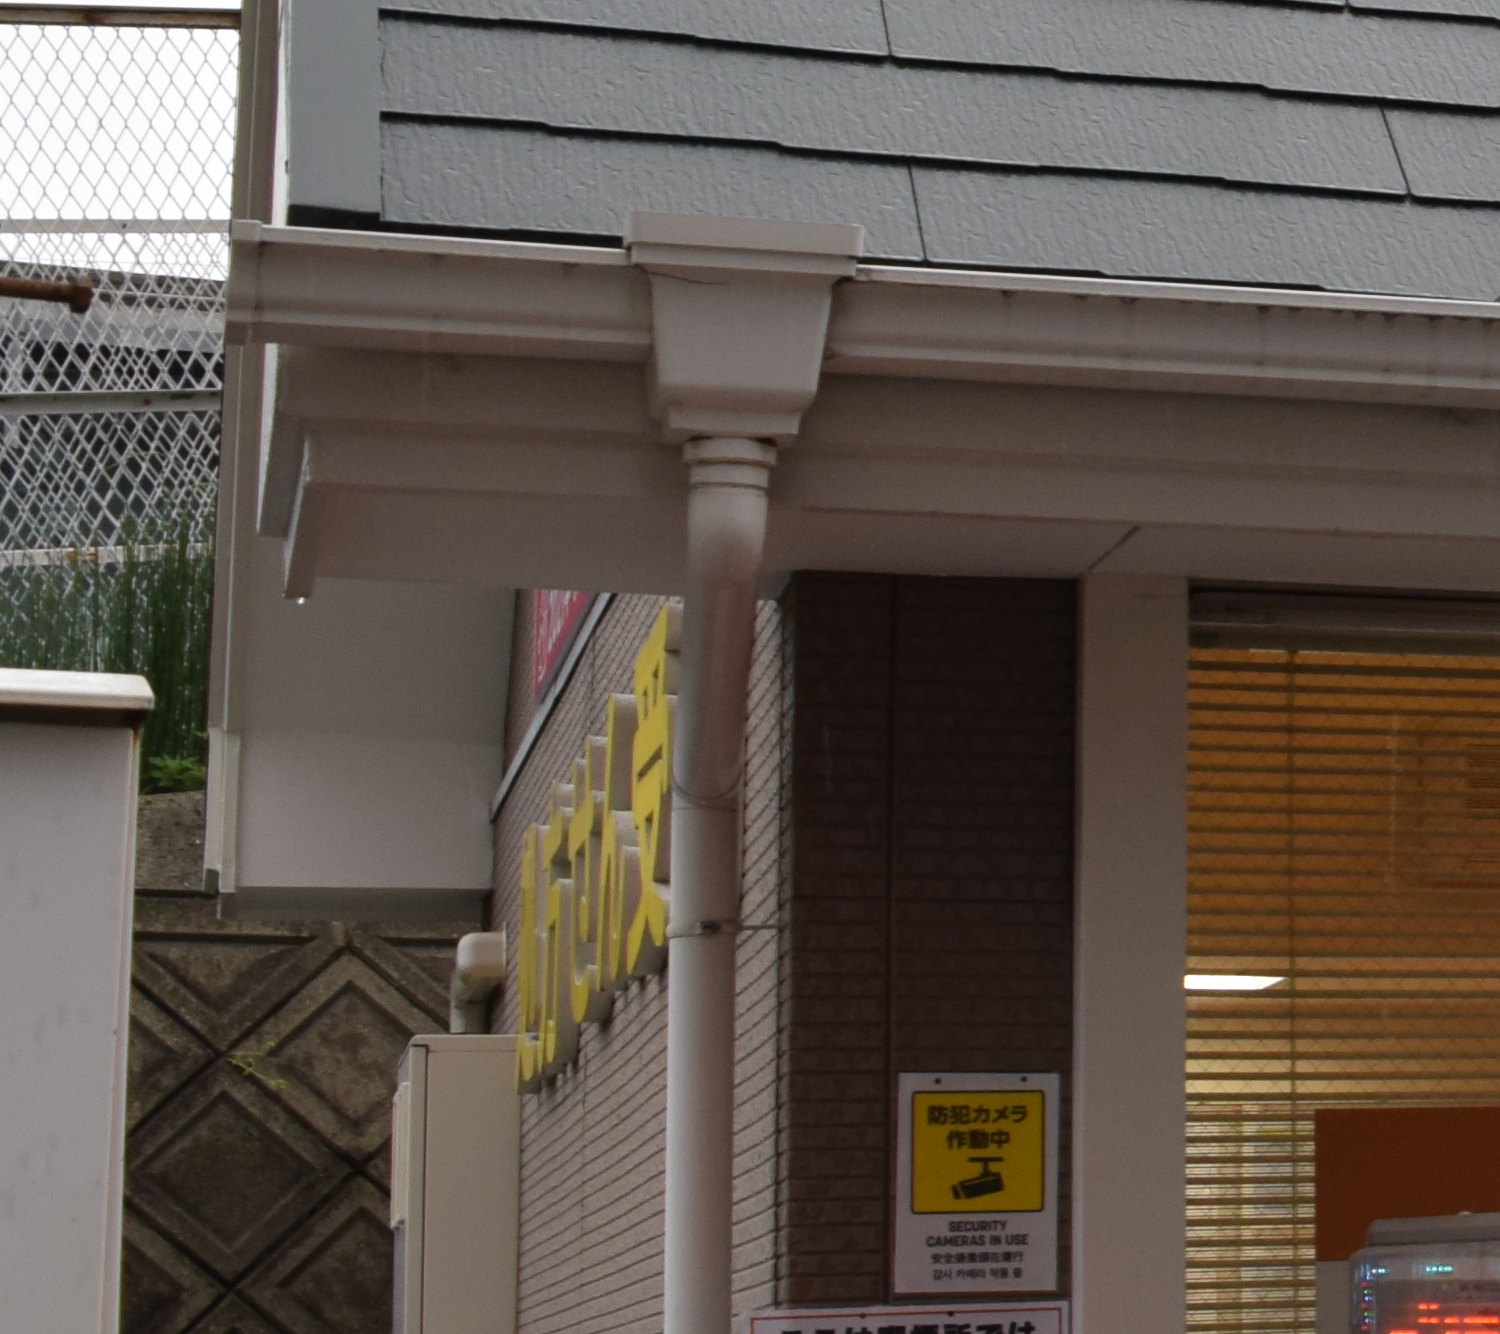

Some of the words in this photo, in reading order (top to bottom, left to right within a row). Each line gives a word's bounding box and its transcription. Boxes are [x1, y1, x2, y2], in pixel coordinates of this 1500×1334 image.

[927, 1104, 1029, 1125] 防犯カメラ
[946, 1128, 1010, 1150] 作動中
[948, 1220, 1008, 1233] SECURITY
[926, 1234, 985, 1248] CAMERAS
[990, 1234, 1002, 1246] IN
[1006, 1233, 1029, 1246] USE
